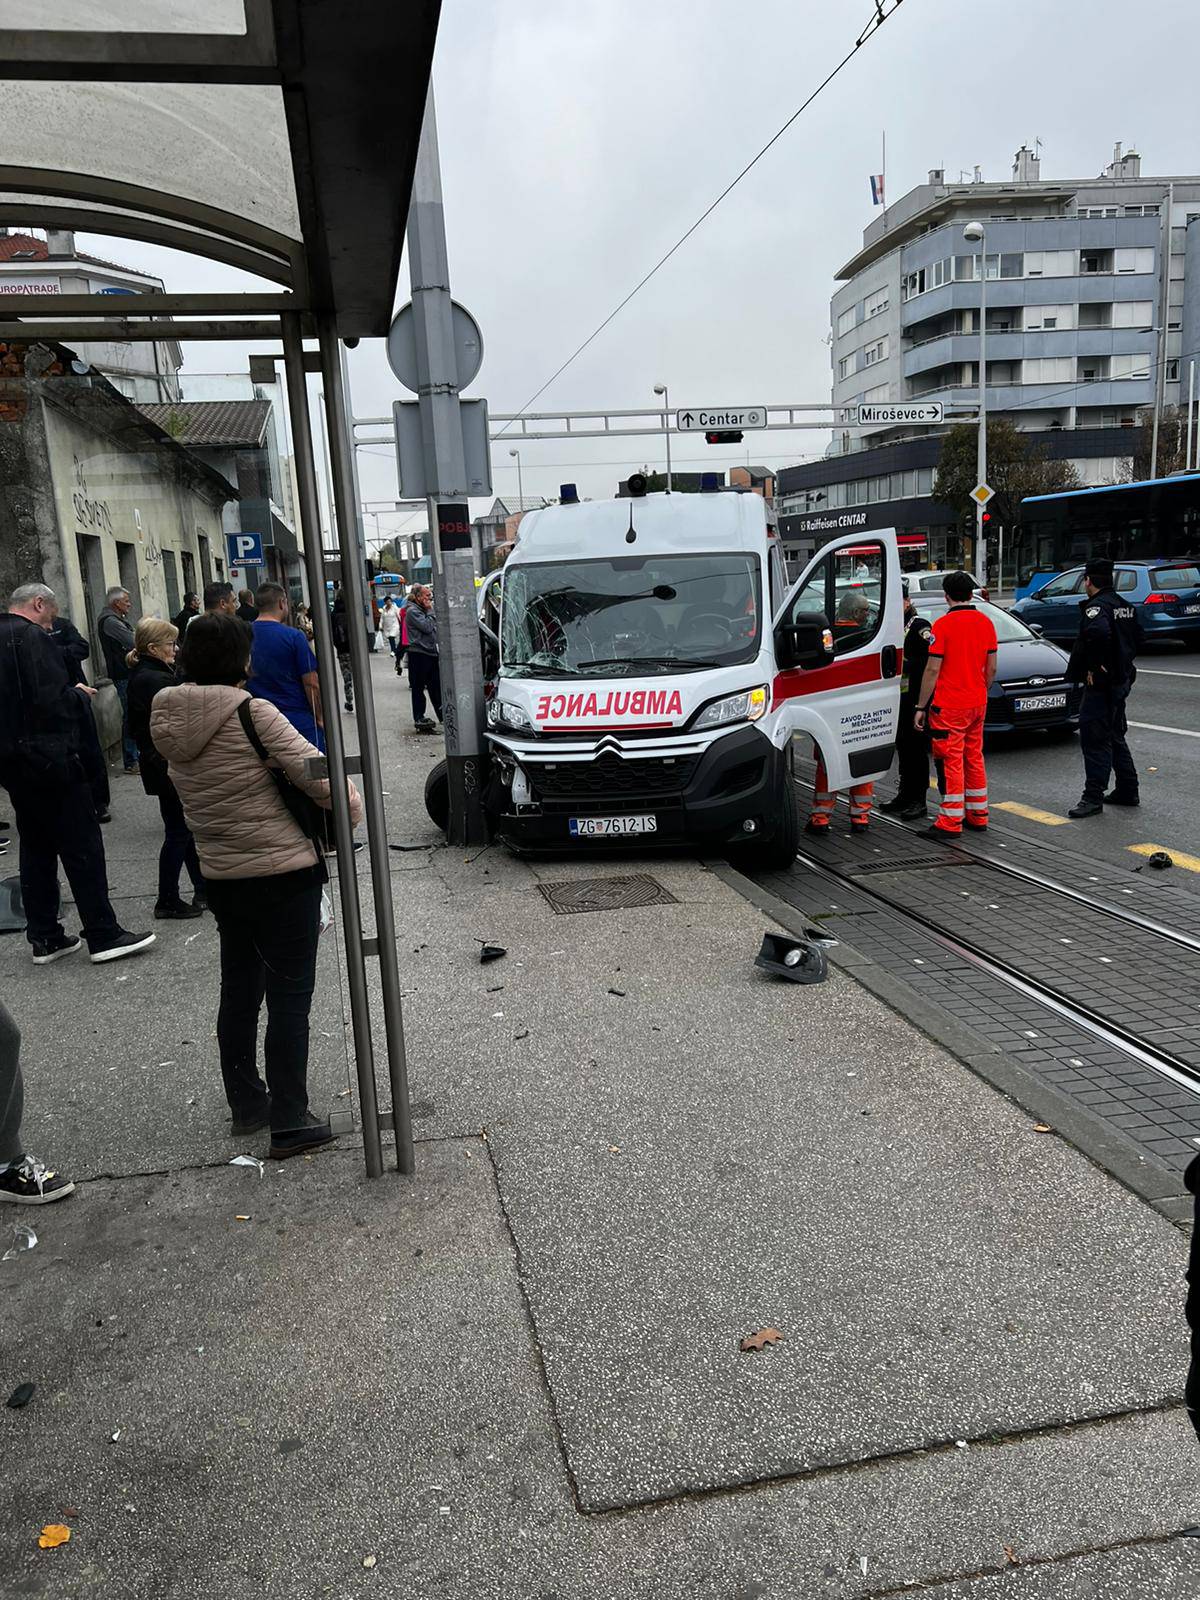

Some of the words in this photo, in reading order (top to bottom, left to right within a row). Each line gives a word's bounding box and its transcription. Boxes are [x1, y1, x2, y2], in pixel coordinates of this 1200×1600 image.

[699, 412, 745, 426] Centar
[861, 407, 925, 421] Miroševec
[806, 517, 838, 531] Raiffeisen
[838, 512, 867, 527] CENTAR
[236, 535, 255, 558] P
[840, 714, 862, 724] ZAVOD
[863, 712, 872, 720] ZA
[872, 707, 892, 717] HITNU
[851, 716, 882, 728] MEDICINU
[578, 820, 595, 834] ZG
